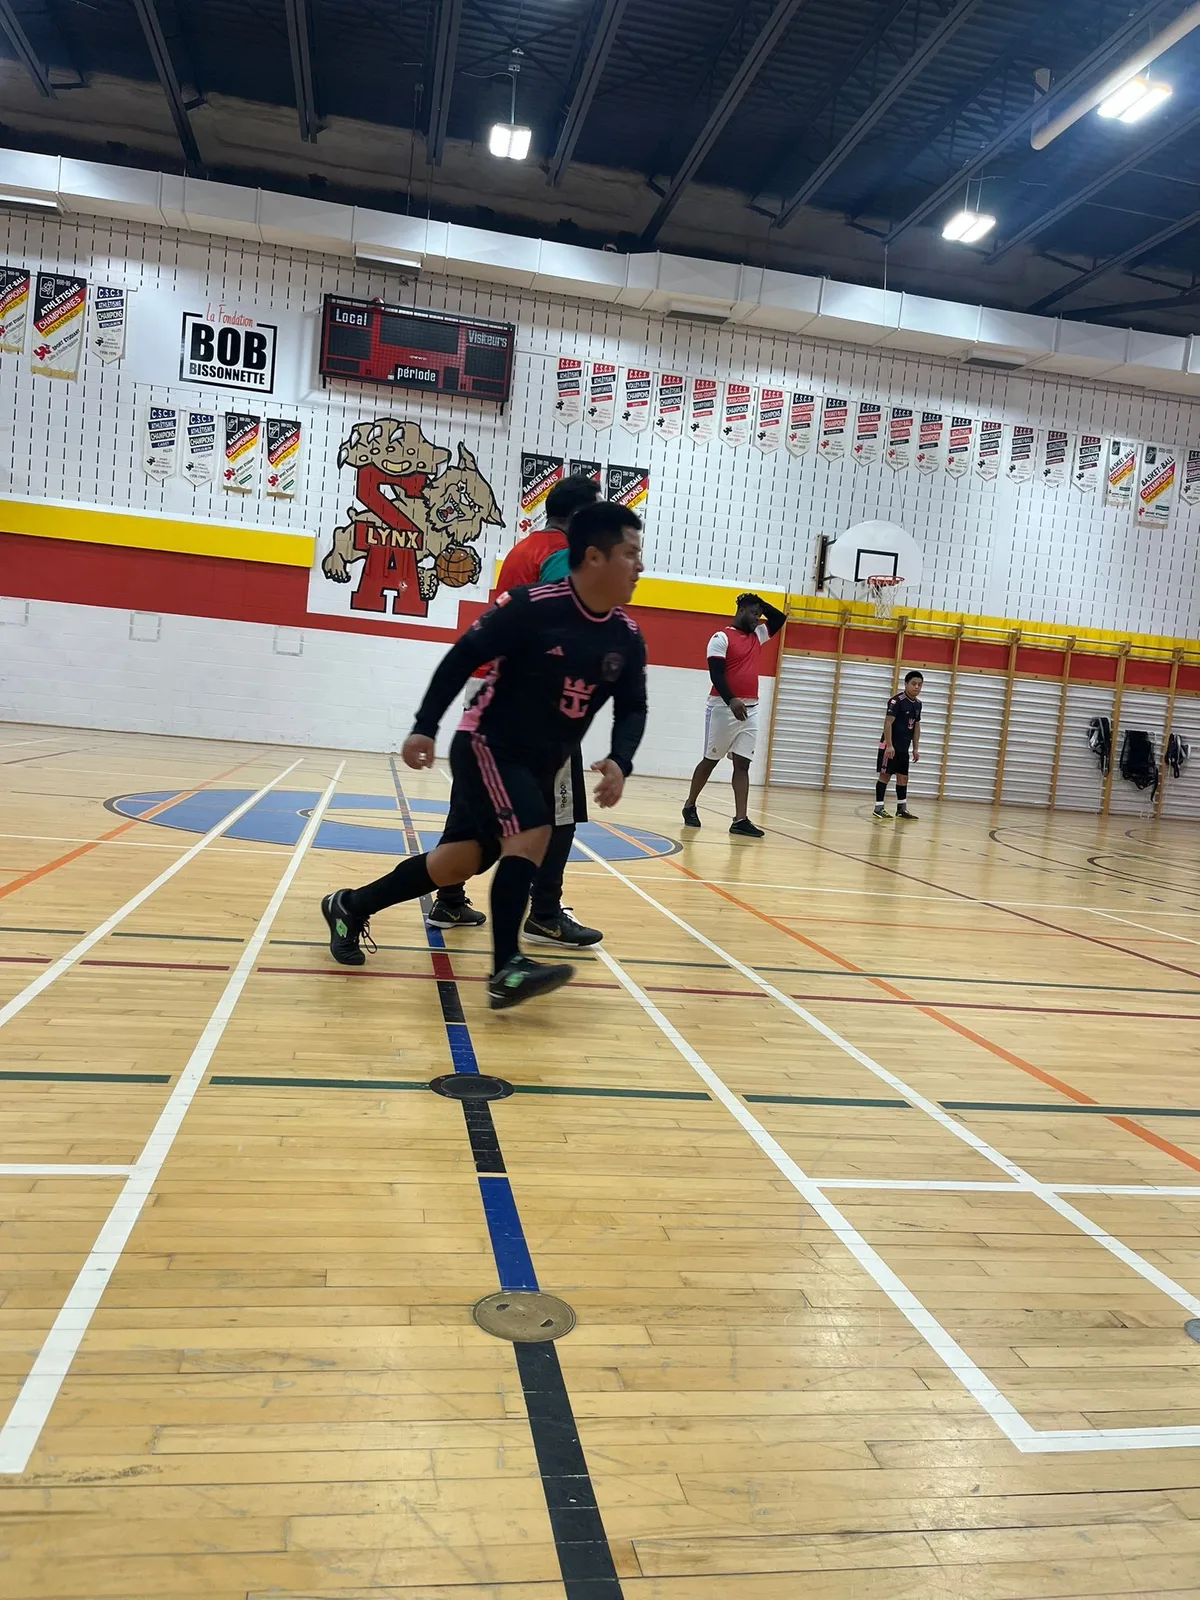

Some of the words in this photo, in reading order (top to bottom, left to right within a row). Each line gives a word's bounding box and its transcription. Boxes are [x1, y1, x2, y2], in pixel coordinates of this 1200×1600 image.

[0, 275, 27, 301] ASKET-BALL
[0, 285, 27, 312] HAMPIONS
[98, 289, 122, 298] C.S.C.S.
[40, 283, 81, 316] ATHLÉTISME
[98, 299, 122, 308] ATHLÉTISME
[38, 296, 82, 330] CHAMPIONNES
[97, 311, 123, 320] CHAMPIONS
[206, 302, 215, 322] La
[218, 304, 254, 328] Fondation
[335, 308, 368, 326] Local
[190, 322, 267, 371] BOB
[468, 329, 508, 348] Visiteurs
[189, 362, 265, 385] BISSONNETTE
[397, 366, 436, 382] période
[151, 409, 174, 418] C.S.C.S.
[190, 415, 213, 424] C.S.C.S.
[726, 406, 748, 414] CHAMPIONS
[761, 411, 780, 419] CHAMPIONS
[150, 431, 175, 440] CHAMPIONS
[151, 421, 174, 429] ATHLÉTISME
[190, 426, 213, 434] ATHLÉTISME
[227, 421, 256, 446] BASKET-BALL
[190, 436, 214, 446] CHAMPIONS
[226, 431, 257, 456] CHAMPIONNES
[269, 427, 298, 451] VOLLEY-BALL
[269, 436, 298, 463] CHAMPIONNES
[523, 462, 559, 494] BASKET-BALL
[1109, 460, 1133, 481] CHAMPIONS
[1141, 456, 1175, 486] BASKET-BALL
[522, 474, 559, 506] CHAMPIONS
[1141, 469, 1173, 497] CHAMPIONS
[619, 485, 644, 505] MPIONS
[367, 527, 419, 549] LYNX
